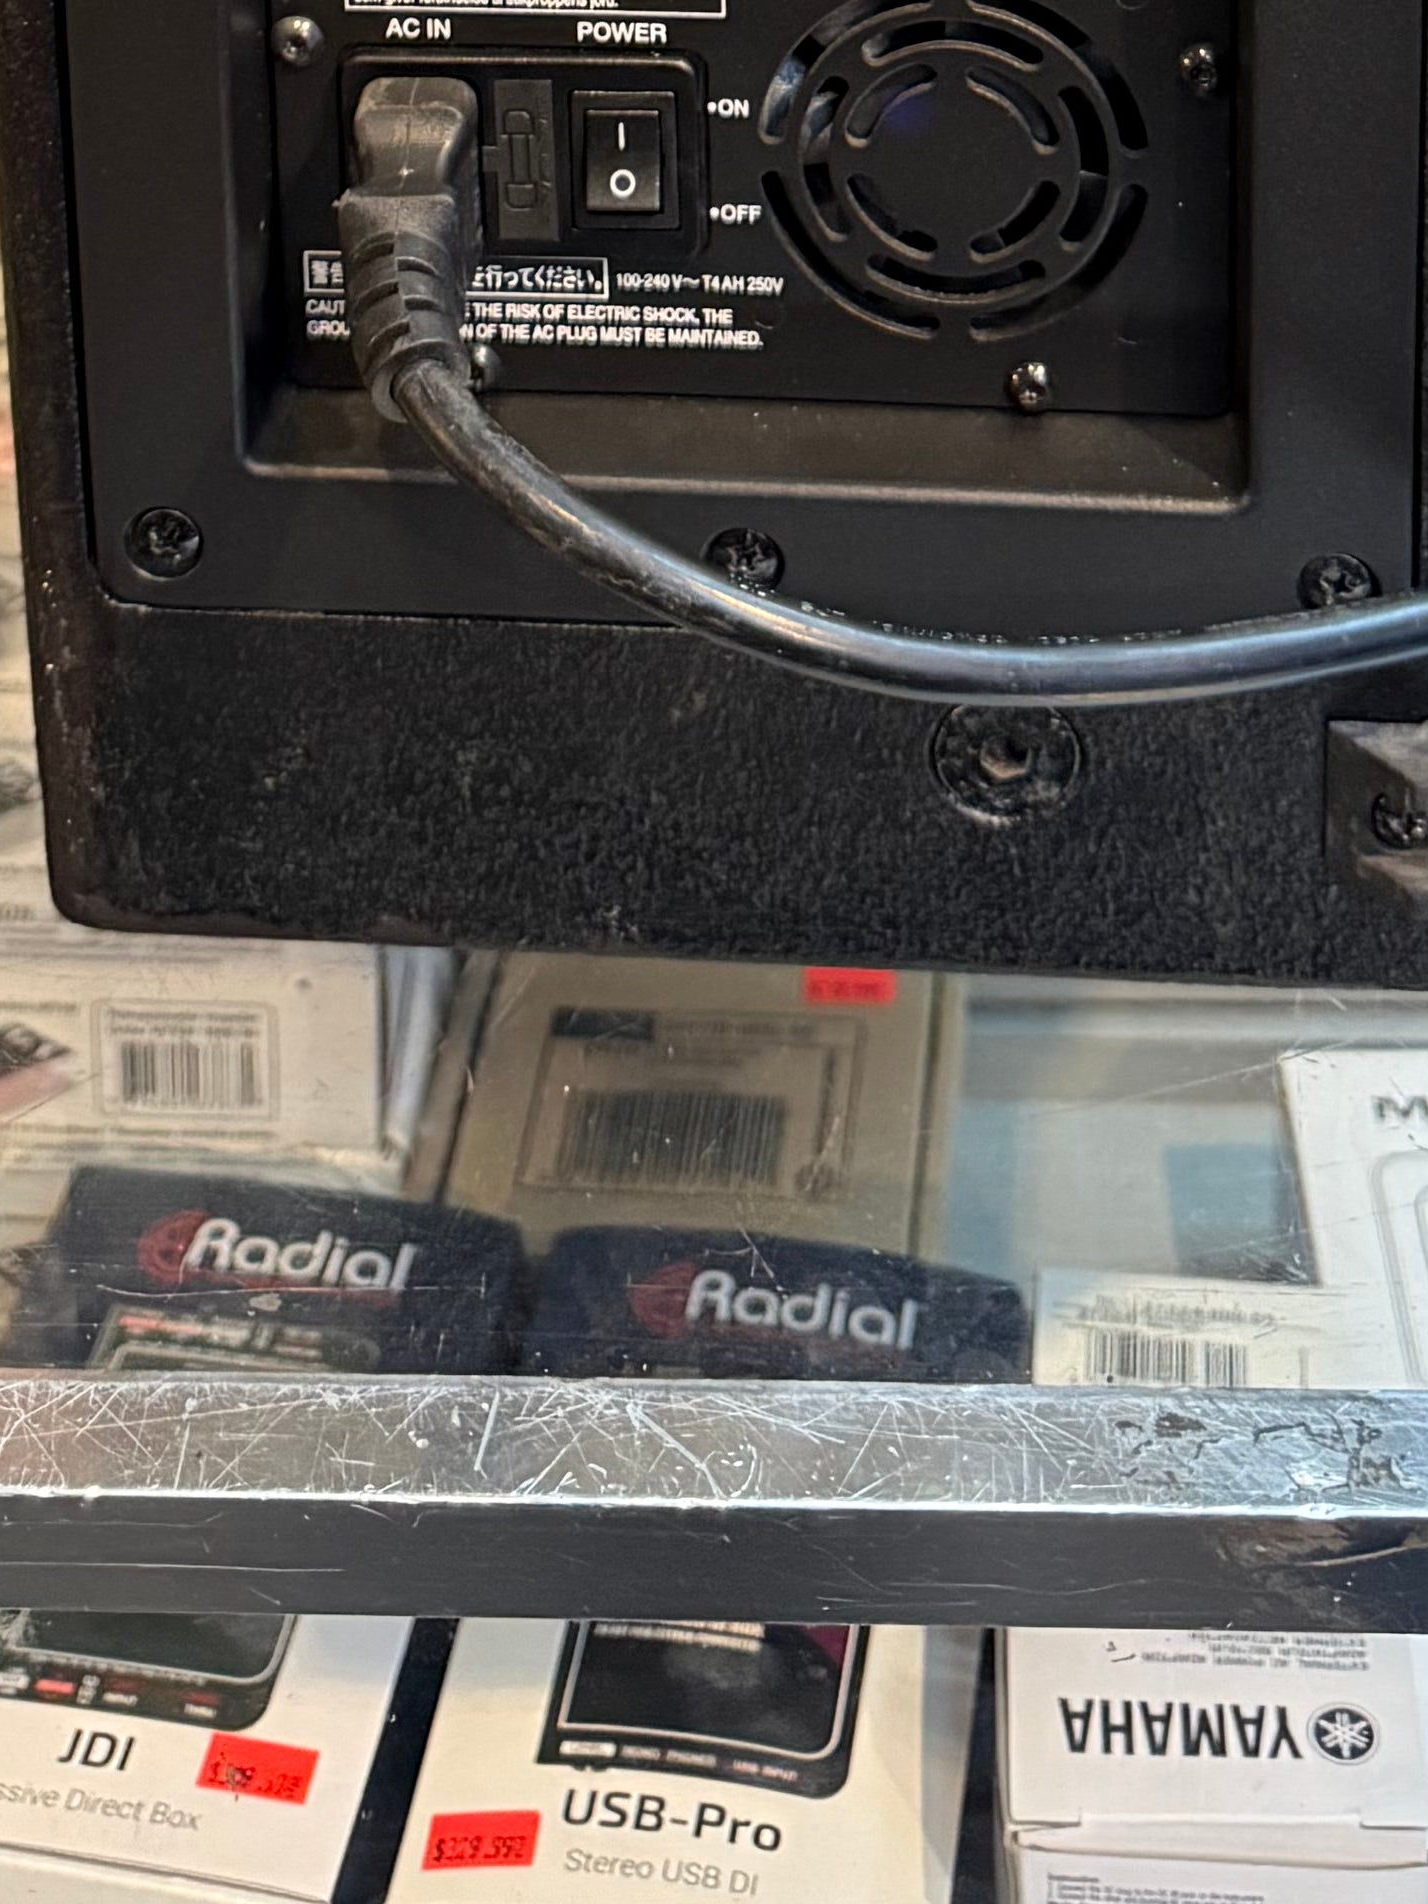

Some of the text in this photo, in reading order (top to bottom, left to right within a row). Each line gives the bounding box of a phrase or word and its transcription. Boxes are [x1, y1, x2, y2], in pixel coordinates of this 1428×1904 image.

[385, 17, 452, 40] AC IN
[576, 21, 667, 44] POWER
[717, 98, 750, 118] ON
[720, 203, 762, 224] OFF
[183, 1217, 418, 1291] Radial
[685, 1269, 918, 1351] Radial
[58, 1728, 137, 1773] JDI
[1057, 1696, 1305, 1760] YAMAHA
[65, 1786, 147, 1822] Direct
[149, 1799, 203, 1831] Box
[560, 1788, 782, 1852] USB-Pro
[563, 1847, 655, 1880] Stereo
[662, 1857, 723, 1890] USB
[728, 1869, 760, 1896] DI
